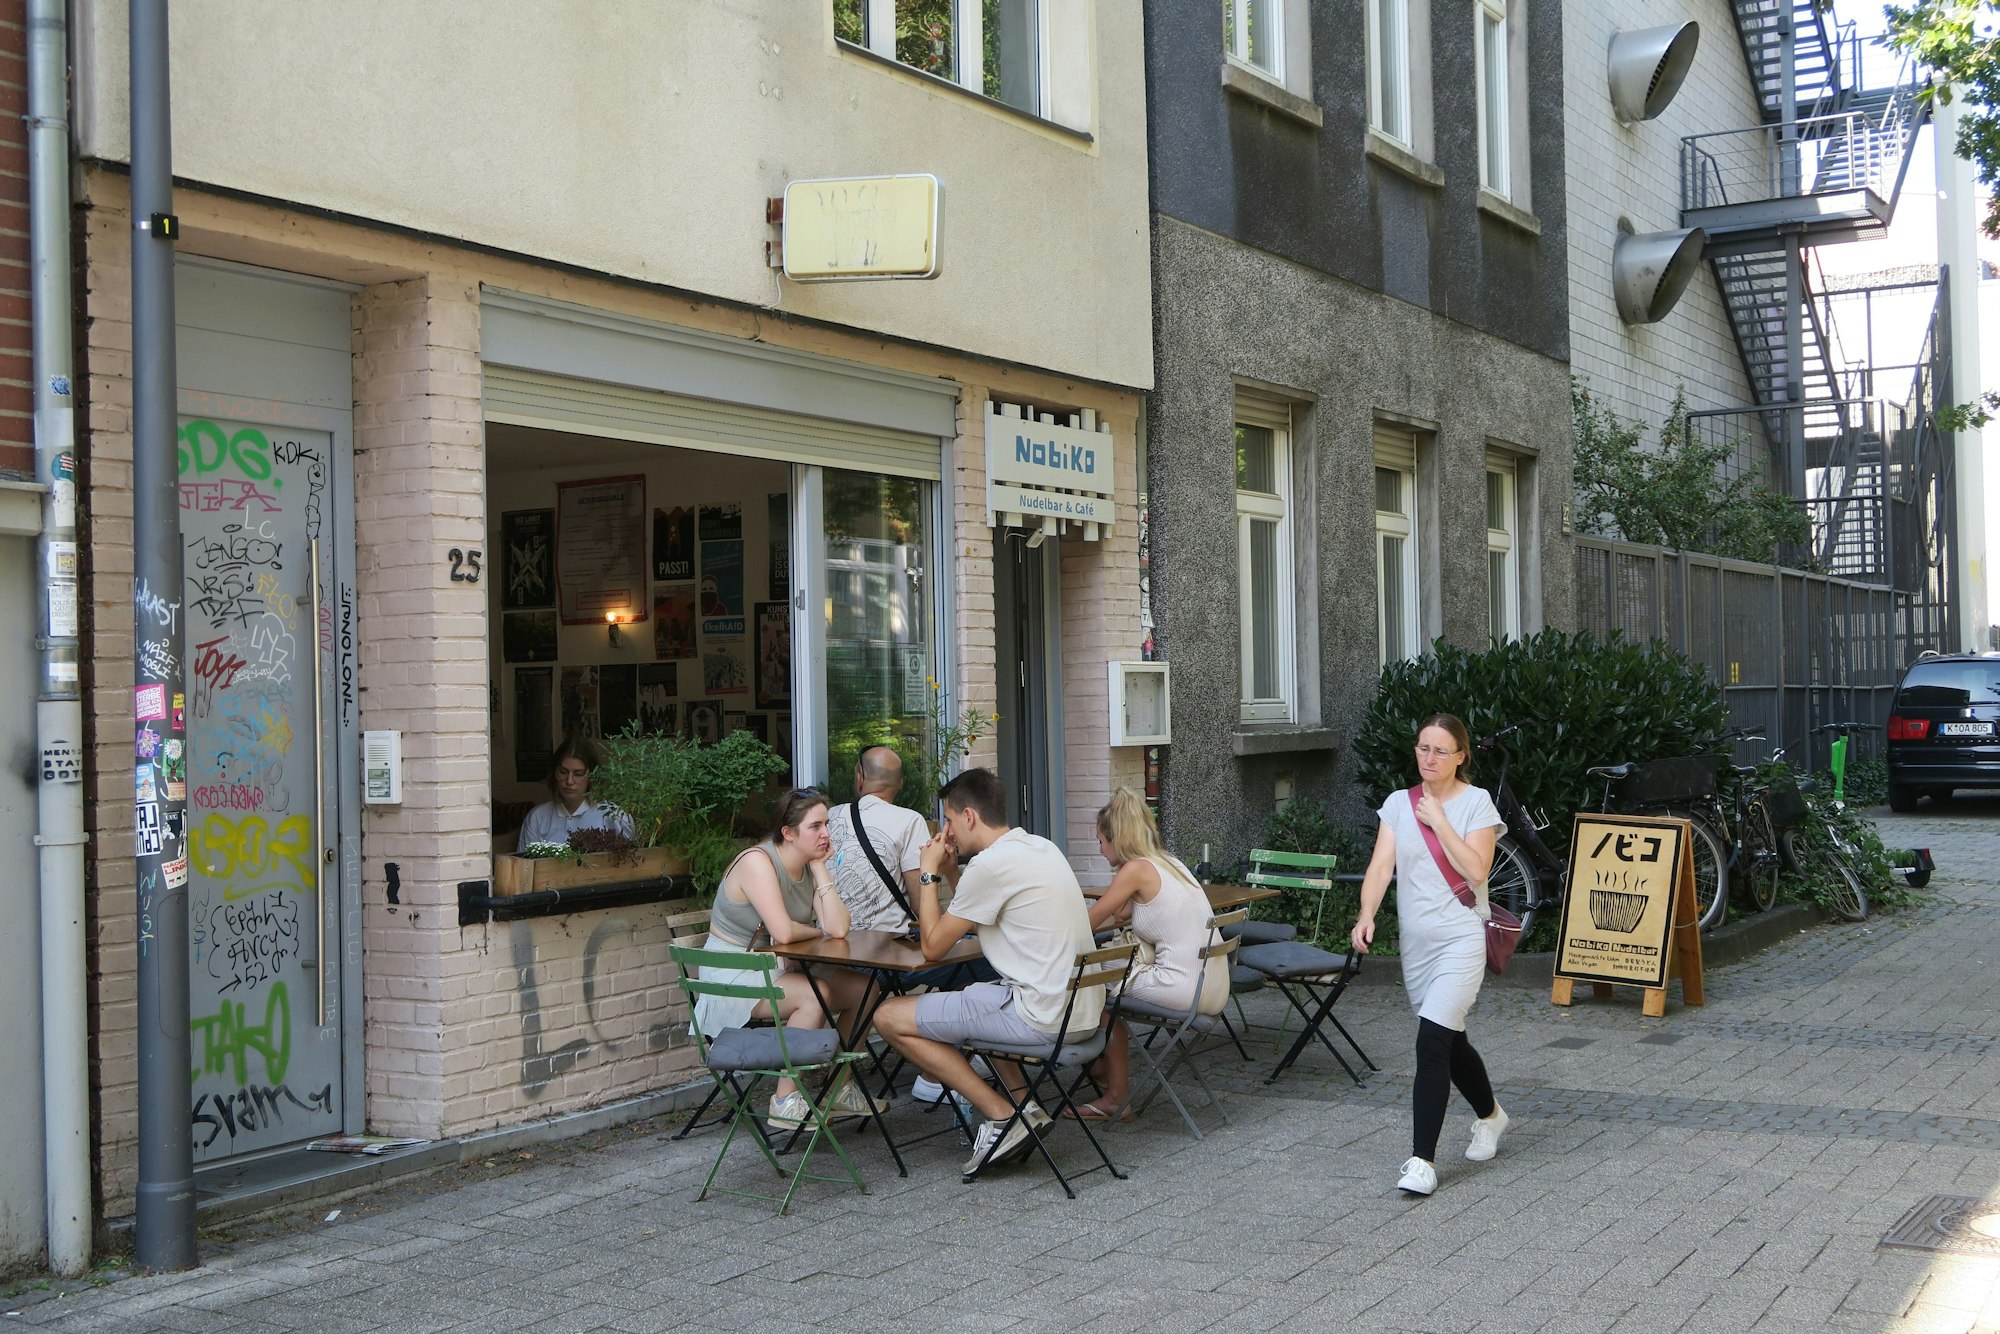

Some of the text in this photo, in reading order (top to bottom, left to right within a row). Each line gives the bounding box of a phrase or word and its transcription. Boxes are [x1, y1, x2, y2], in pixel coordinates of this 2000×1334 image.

[163, 217, 170, 235] 1
[1019, 494, 1094, 516] Nudelbar & Café
[448, 548, 482, 583] 25
[658, 560, 690, 575] PASST!
[1947, 724, 1954, 734] K
[1971, 724, 1989, 733] 805
[1590, 832, 1662, 863] ノビコ
[1612, 943, 1658, 956] Nudelbar
